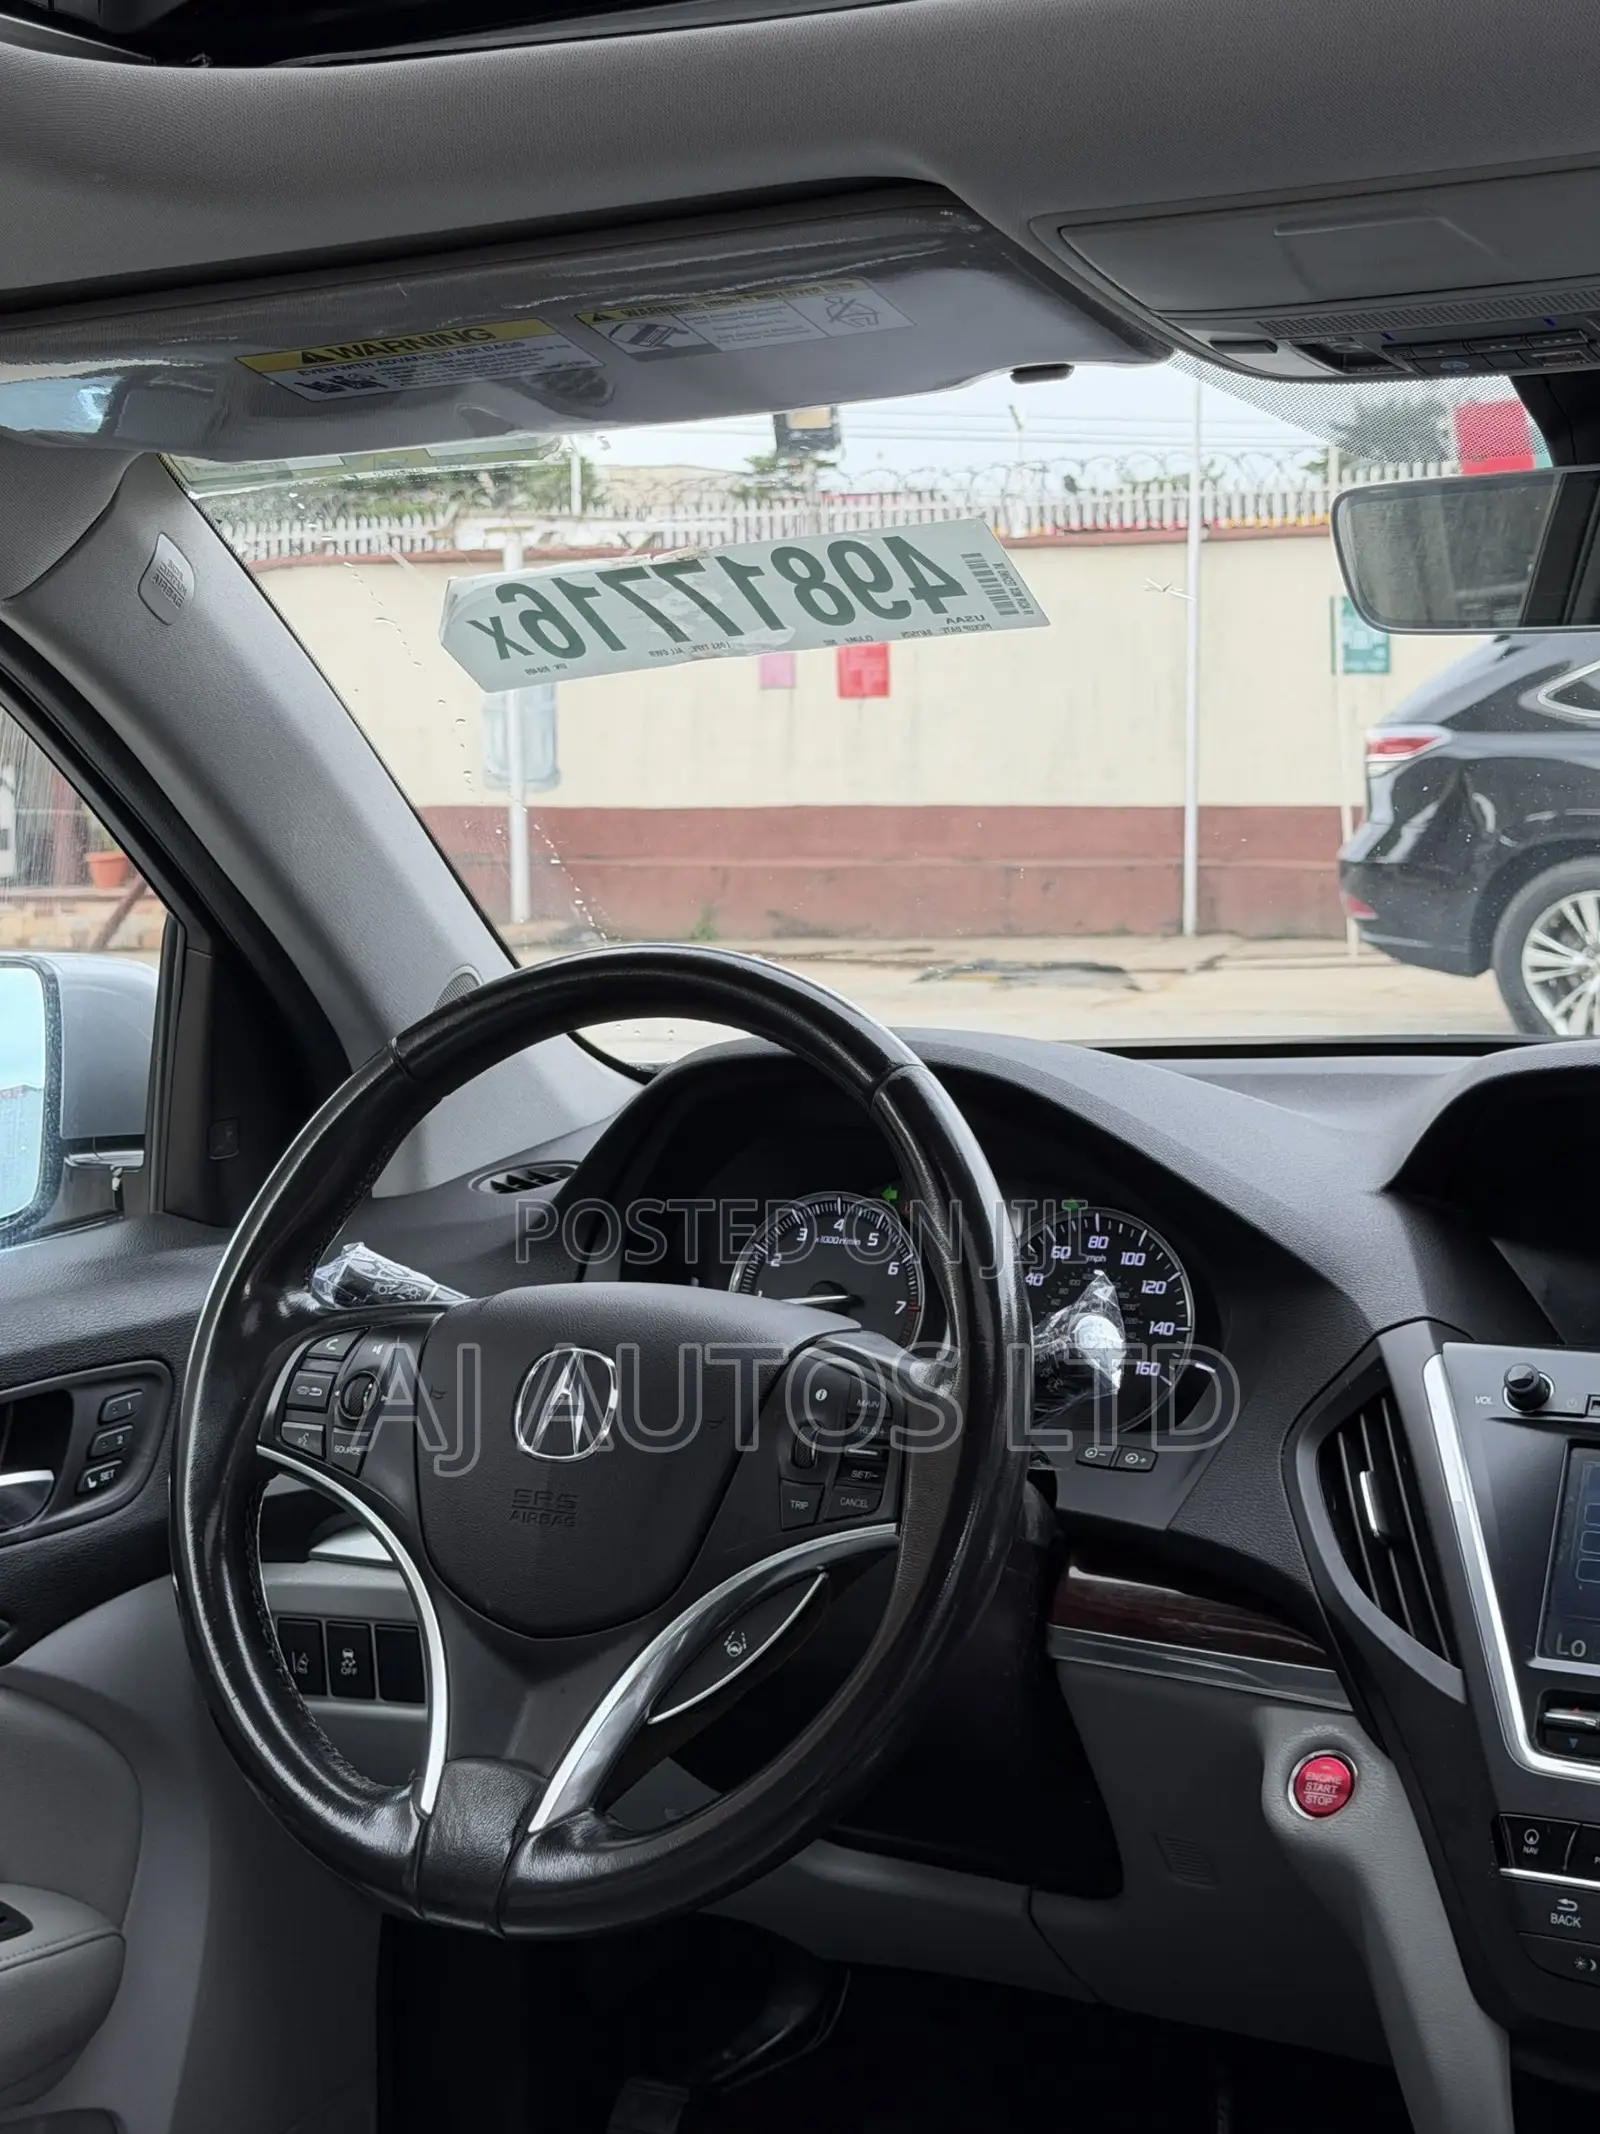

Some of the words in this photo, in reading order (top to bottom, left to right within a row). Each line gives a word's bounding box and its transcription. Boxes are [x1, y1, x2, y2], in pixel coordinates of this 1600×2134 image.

[326, 327, 496, 360] WARNING
[834, 1218, 845, 1231] 4
[796, 1227, 809, 1241] 3
[867, 1232, 880, 1247] 5
[1087, 1235, 1110, 1249] 80
[1050, 1245, 1072, 1260] 60
[1086, 1254, 1107, 1263] mph
[1120, 1251, 1146, 1266] 100
[770, 1253, 783, 1268] 2
[888, 1261, 900, 1276] 6
[1025, 1272, 1045, 1287] 40
[1140, 1279, 1167, 1295] 120
[894, 1300, 908, 1315] 7
[1148, 1320, 1176, 1336] 140
[1134, 1360, 1162, 1377] 160
[856, 1398, 880, 1409] MAIN
[1475, 1395, 1494, 1406] VOL
[116, 1434, 124, 1445] 2
[333, 1443, 362, 1456] SOURCE
[100, 1469, 116, 1482] SET
[512, 1488, 580, 1510] SRS
[790, 1499, 810, 1511] TRIP
[839, 1497, 869, 1509] CANCEL
[509, 1510, 576, 1528] AIRBAG
[340, 1667, 359, 1677] OFF
[1305, 1771, 1343, 1785] ENGINE
[1305, 1780, 1339, 1795] START
[1305, 1794, 1334, 1807] STOP
[1522, 1845, 1540, 1856] NAV
[1549, 1911, 1582, 1929] BACK
